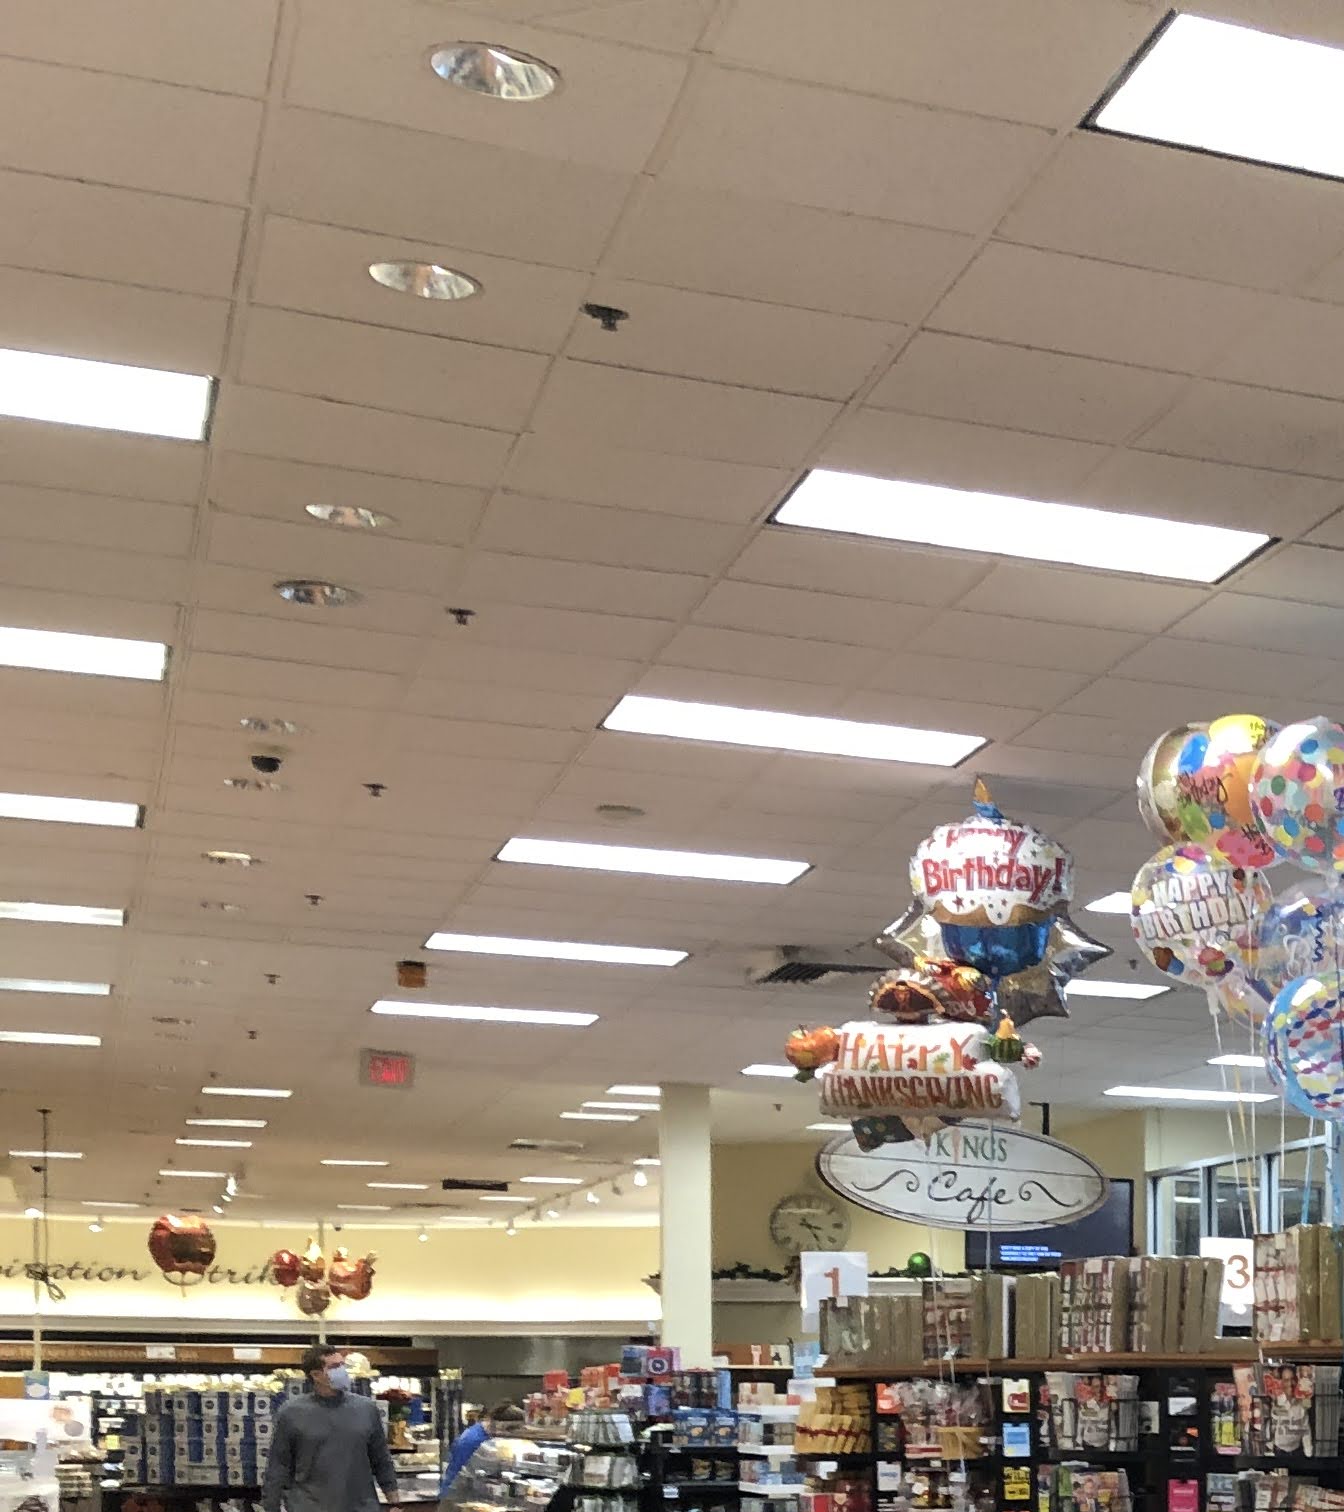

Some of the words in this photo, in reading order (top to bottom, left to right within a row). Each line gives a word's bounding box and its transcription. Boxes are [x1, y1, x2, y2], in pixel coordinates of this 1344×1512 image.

[922, 856, 1066, 903] Birthday!
[1151, 872, 1229, 902] HAPPY
[1140, 896, 1255, 939] BIRTHDAY
[821, 1071, 1004, 1110] THANKSGIVING
[934, 1129, 1009, 1163] KINGS
[823, 1267, 841, 1297] 1
[1225, 1254, 1250, 1289] 3
